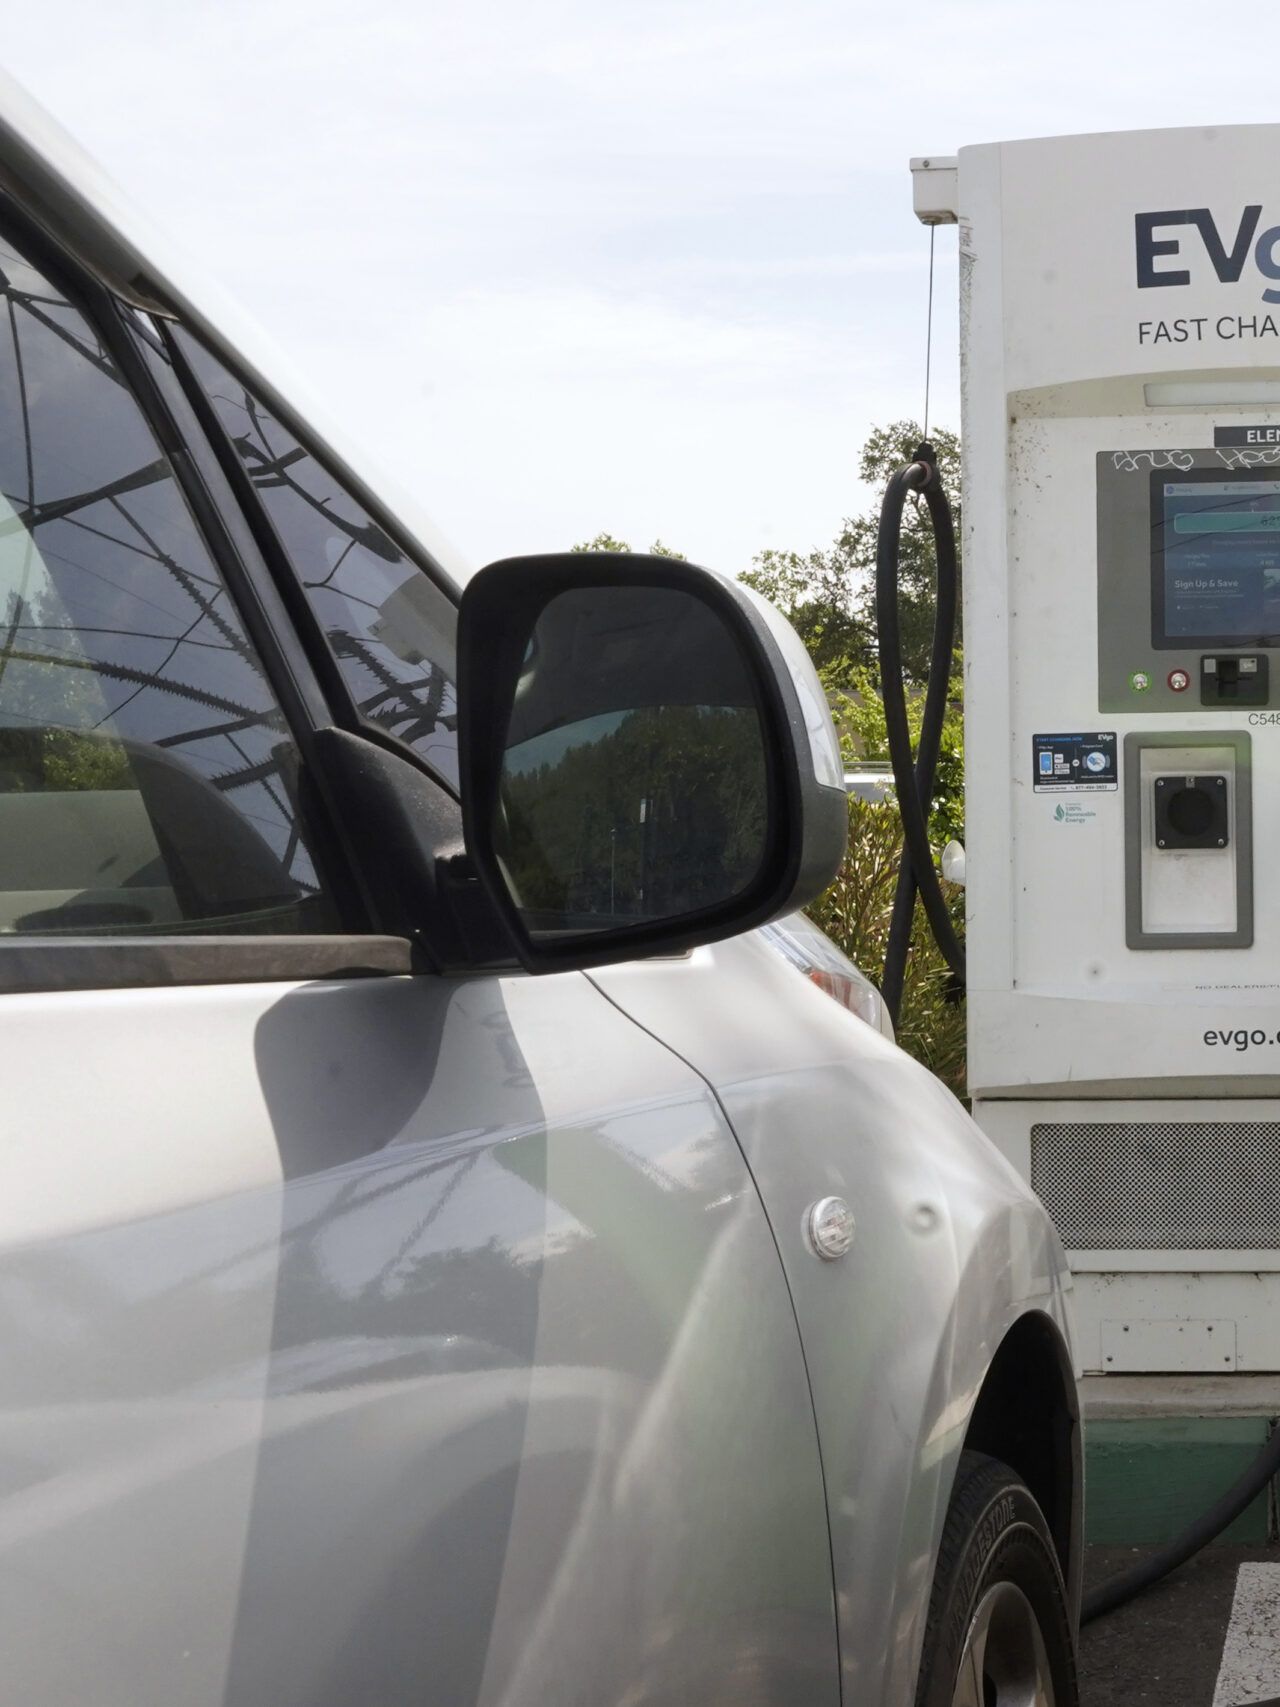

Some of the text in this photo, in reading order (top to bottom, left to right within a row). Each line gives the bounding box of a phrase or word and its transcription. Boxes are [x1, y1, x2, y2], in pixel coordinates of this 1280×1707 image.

[1139, 318, 1208, 344] FAST
[1175, 579, 1239, 590] Sign Up & Save
